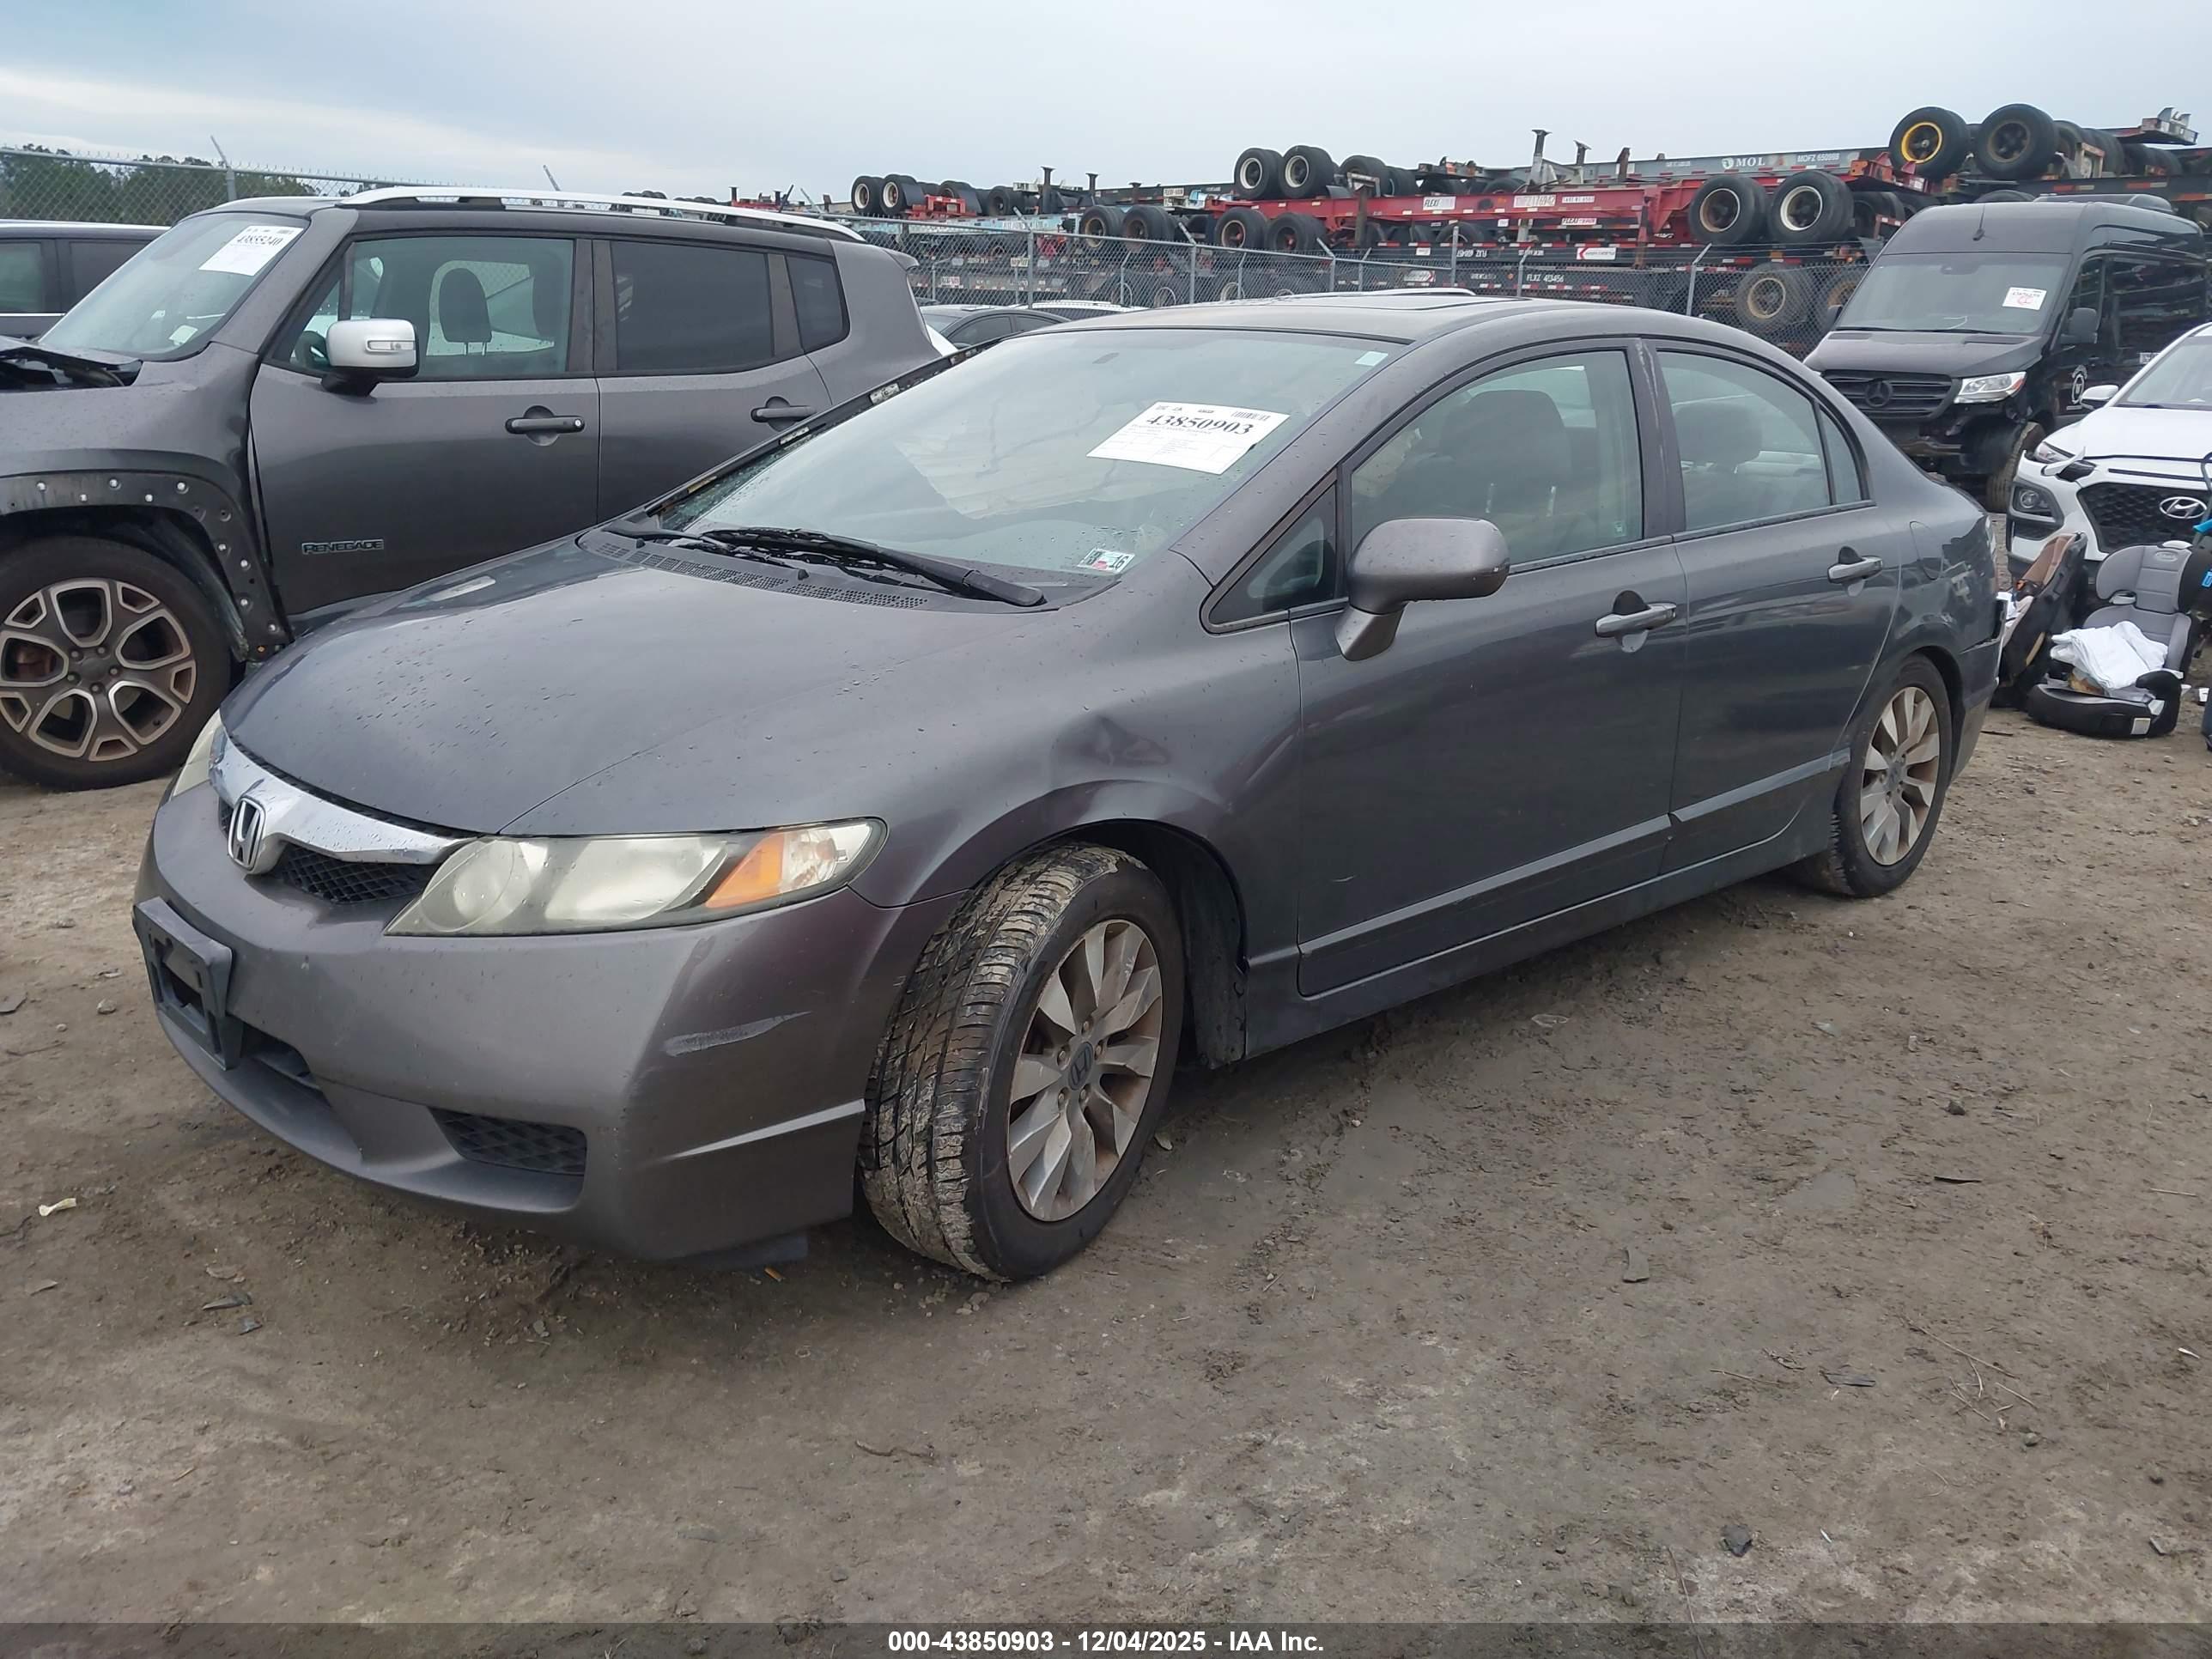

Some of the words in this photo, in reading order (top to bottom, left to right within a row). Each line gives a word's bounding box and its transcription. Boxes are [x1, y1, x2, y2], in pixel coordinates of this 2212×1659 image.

[1735, 157, 1765, 167] MOL
[1146, 415, 1254, 434] 43850903
[302, 540, 385, 555] RENEGADE
